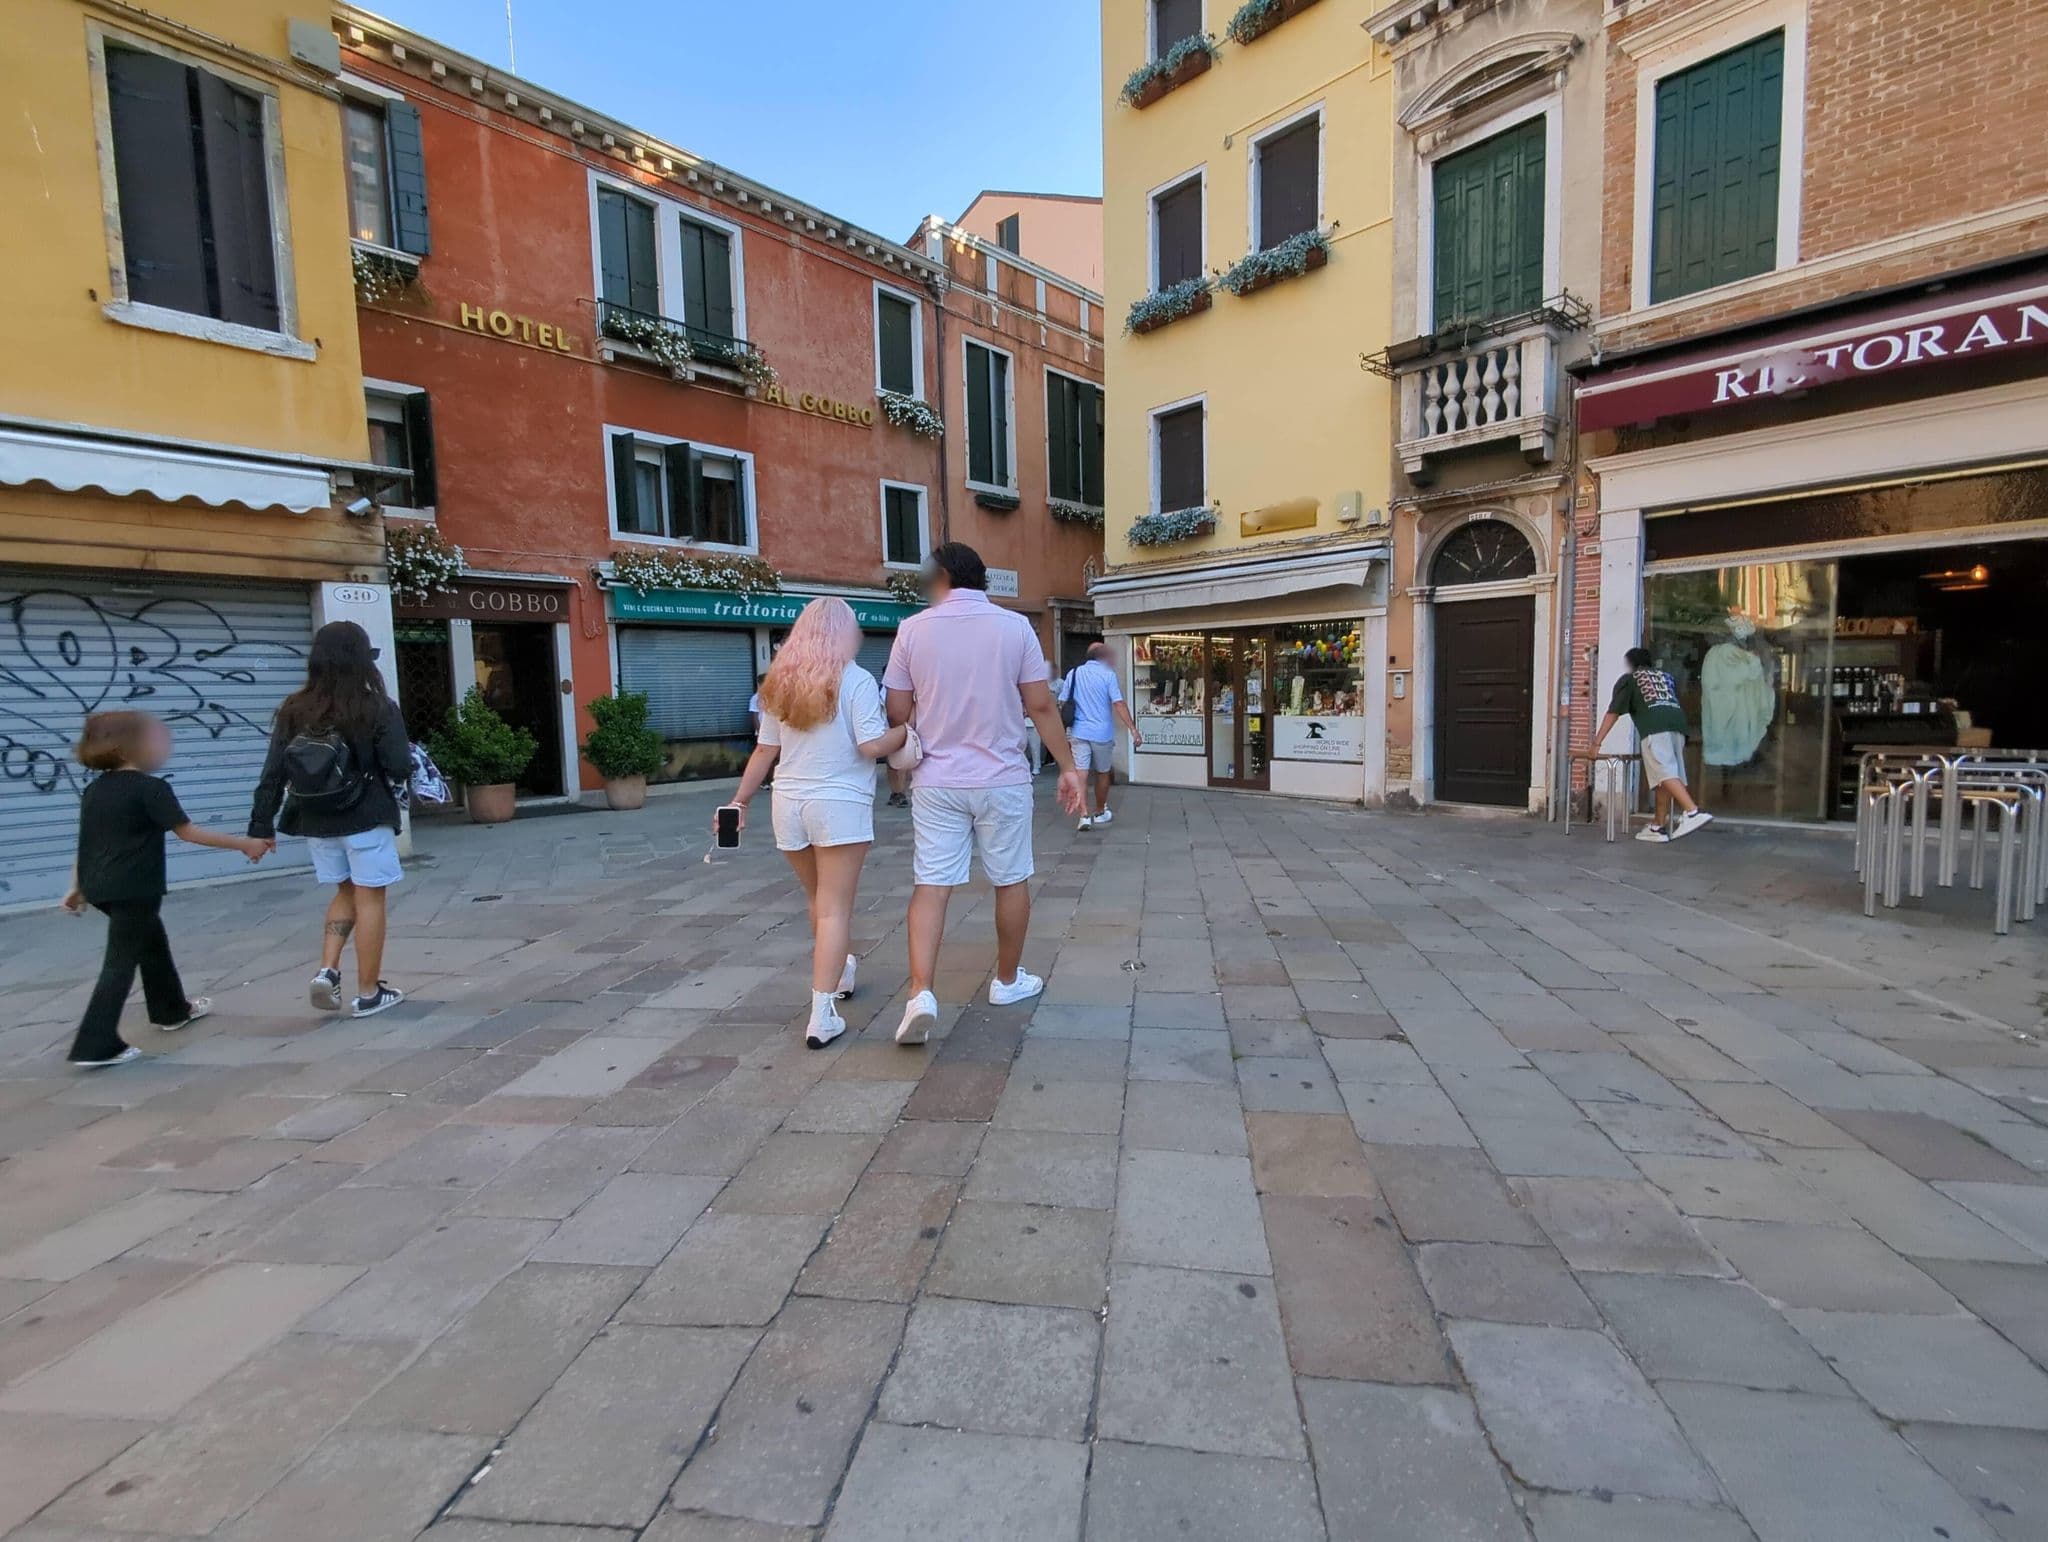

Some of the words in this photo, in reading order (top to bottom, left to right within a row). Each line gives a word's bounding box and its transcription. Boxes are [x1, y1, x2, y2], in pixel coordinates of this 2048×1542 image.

[461, 302, 571, 351] HOTEL
[1712, 304, 2048, 403] RITORAN
[767, 384, 793, 406] AL
[800, 391, 873, 426] GOBBO
[469, 590, 558, 613] GOBBO
[714, 601, 797, 618] trattoria
